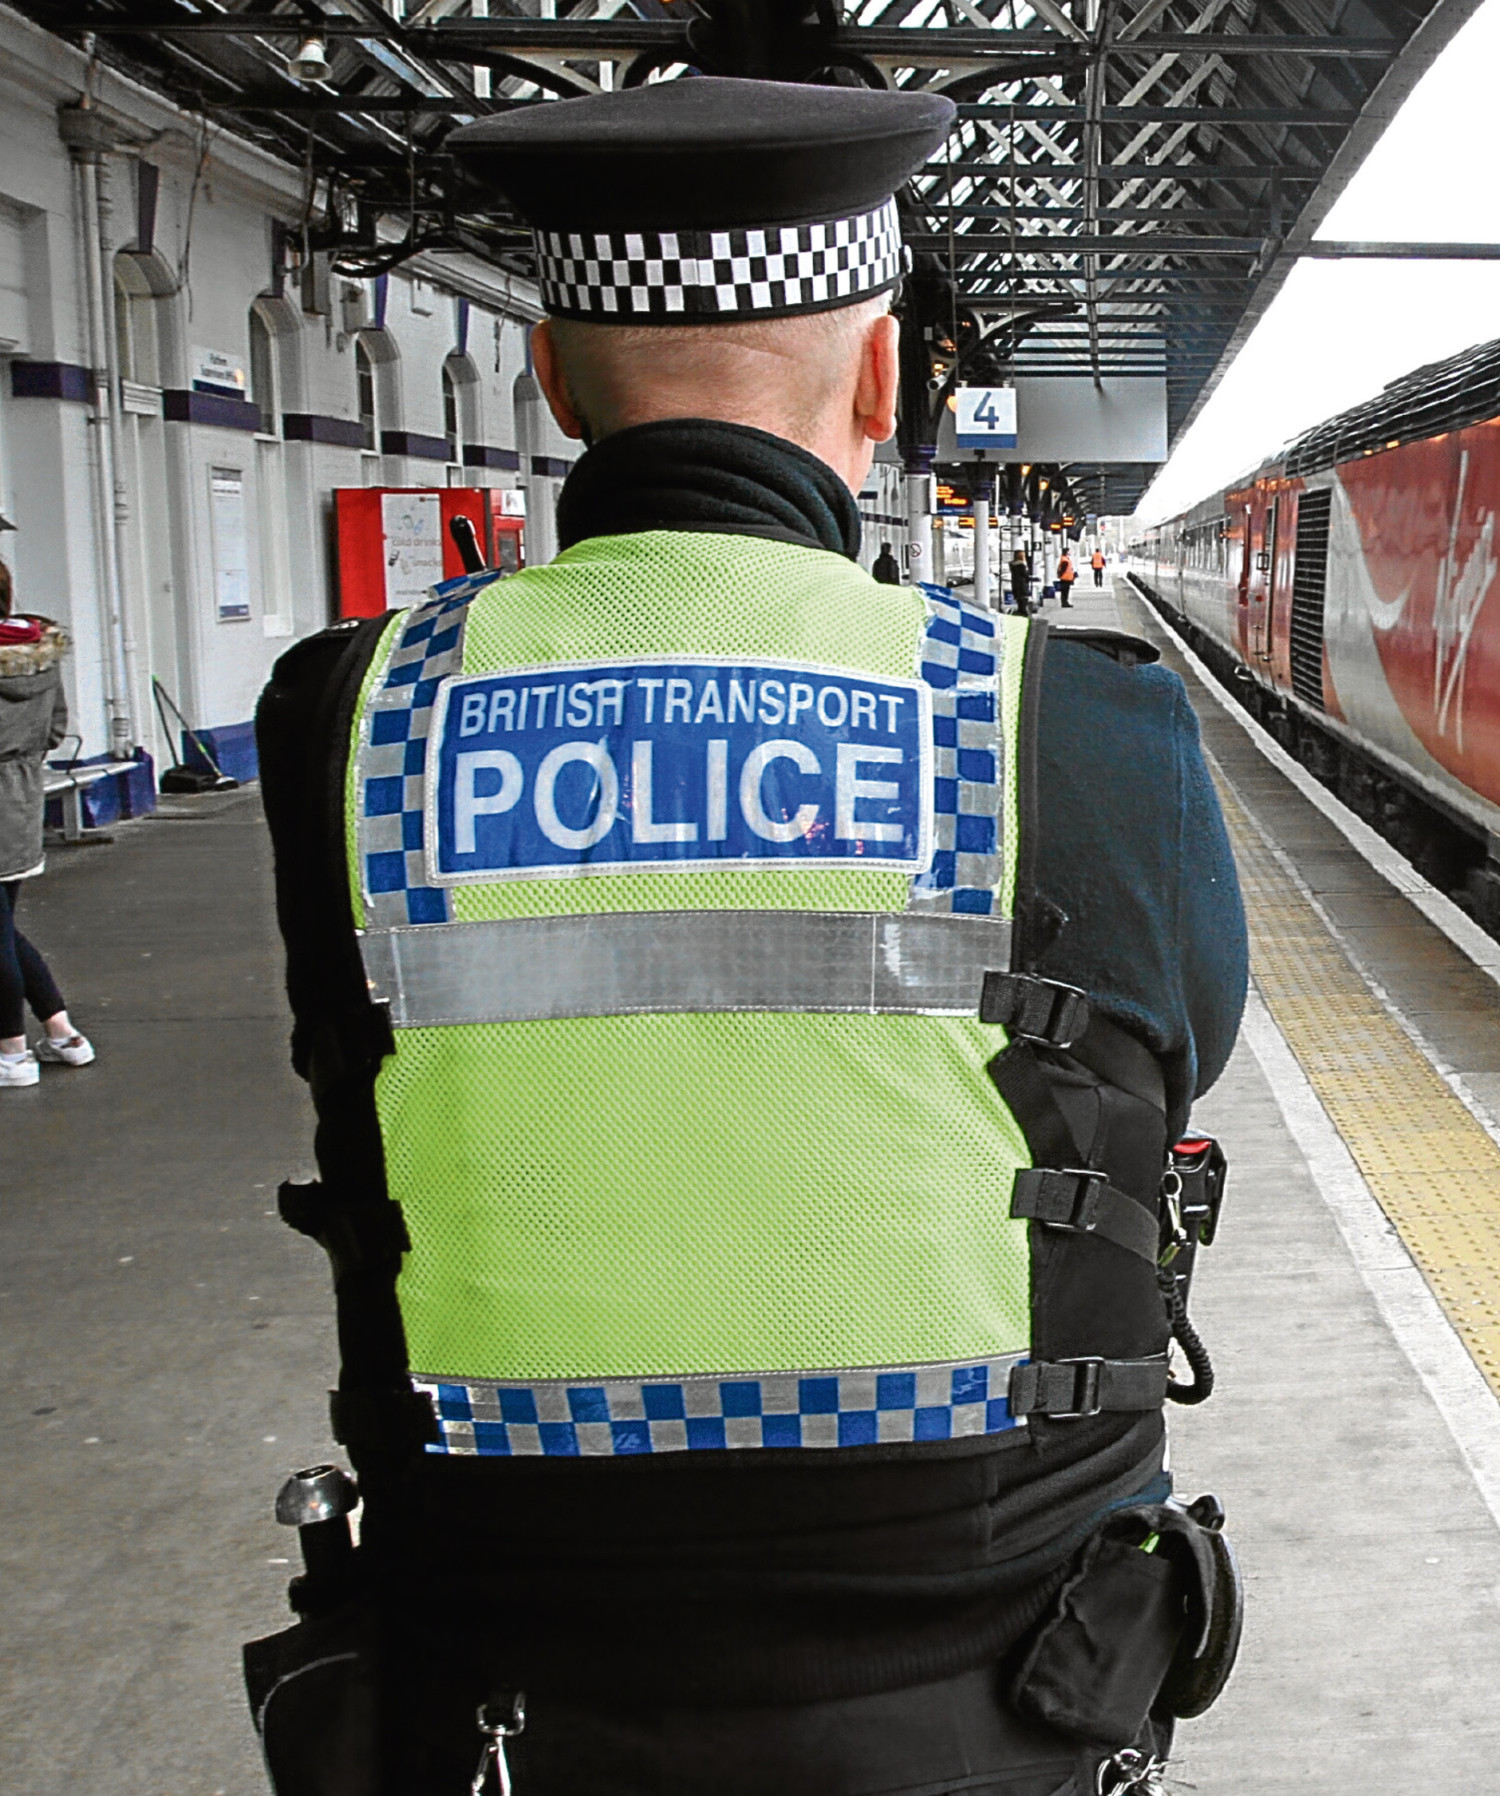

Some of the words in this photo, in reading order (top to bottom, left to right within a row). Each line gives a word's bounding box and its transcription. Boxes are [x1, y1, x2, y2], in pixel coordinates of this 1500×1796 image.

[973, 391, 1000, 430] 4
[459, 679, 627, 737] BRITISH
[637, 678, 904, 734] TRANSPORT
[454, 738, 904, 854] POLICE
